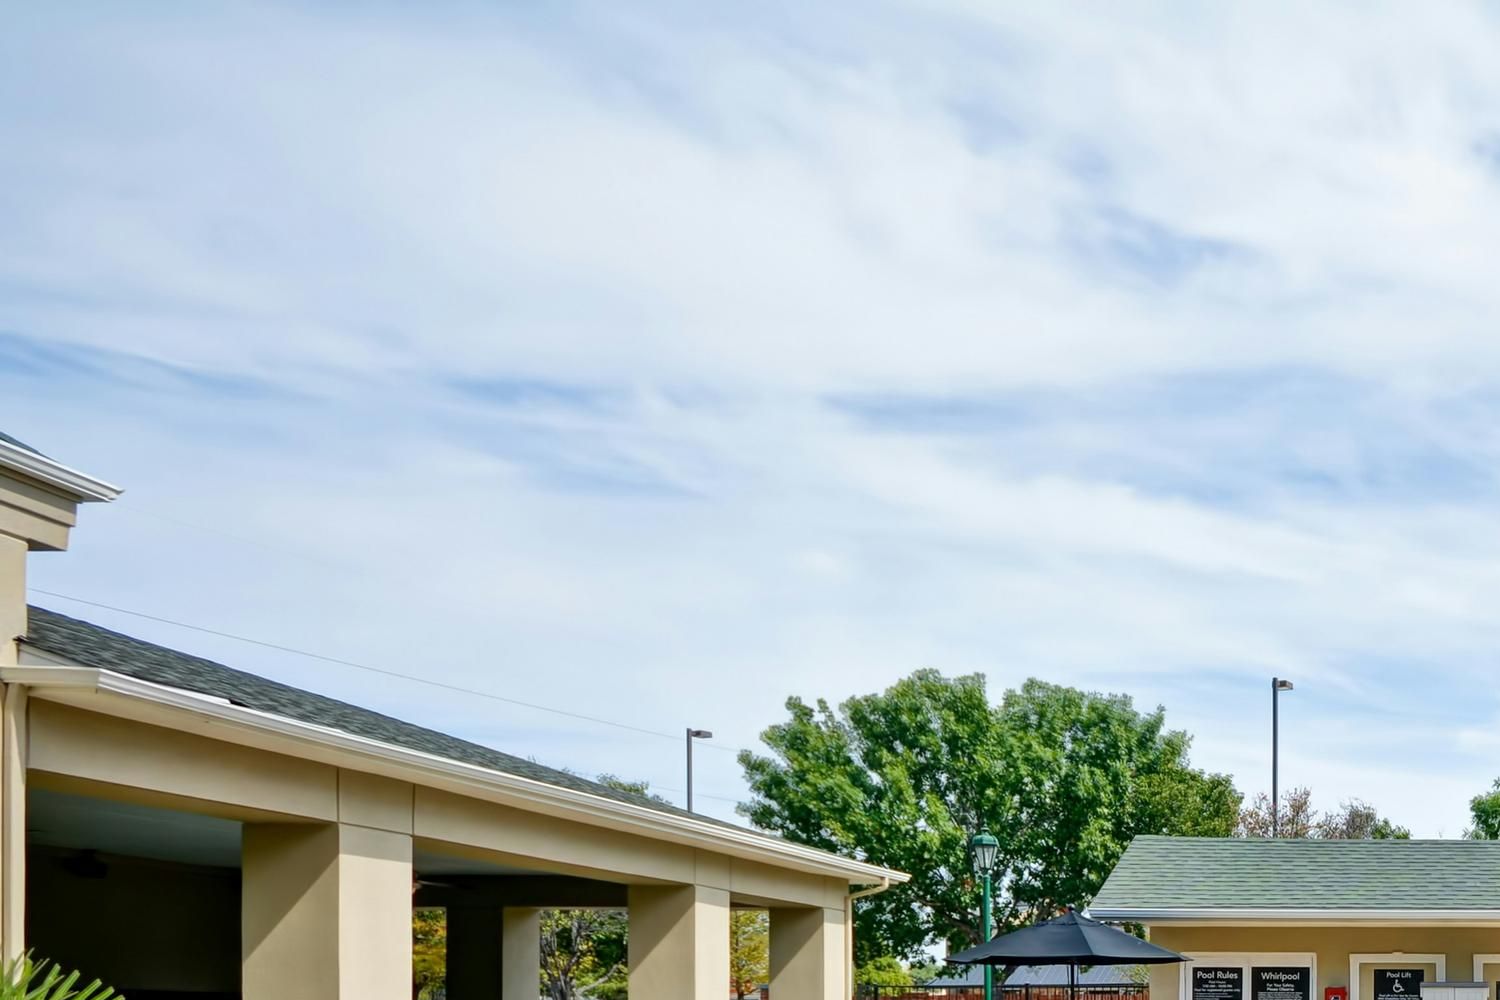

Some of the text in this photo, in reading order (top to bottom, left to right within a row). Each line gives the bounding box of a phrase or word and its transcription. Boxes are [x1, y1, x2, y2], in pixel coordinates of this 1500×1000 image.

[1197, 971, 1239, 979] Pool Rules
[1261, 972, 1300, 982] Whirlpool
